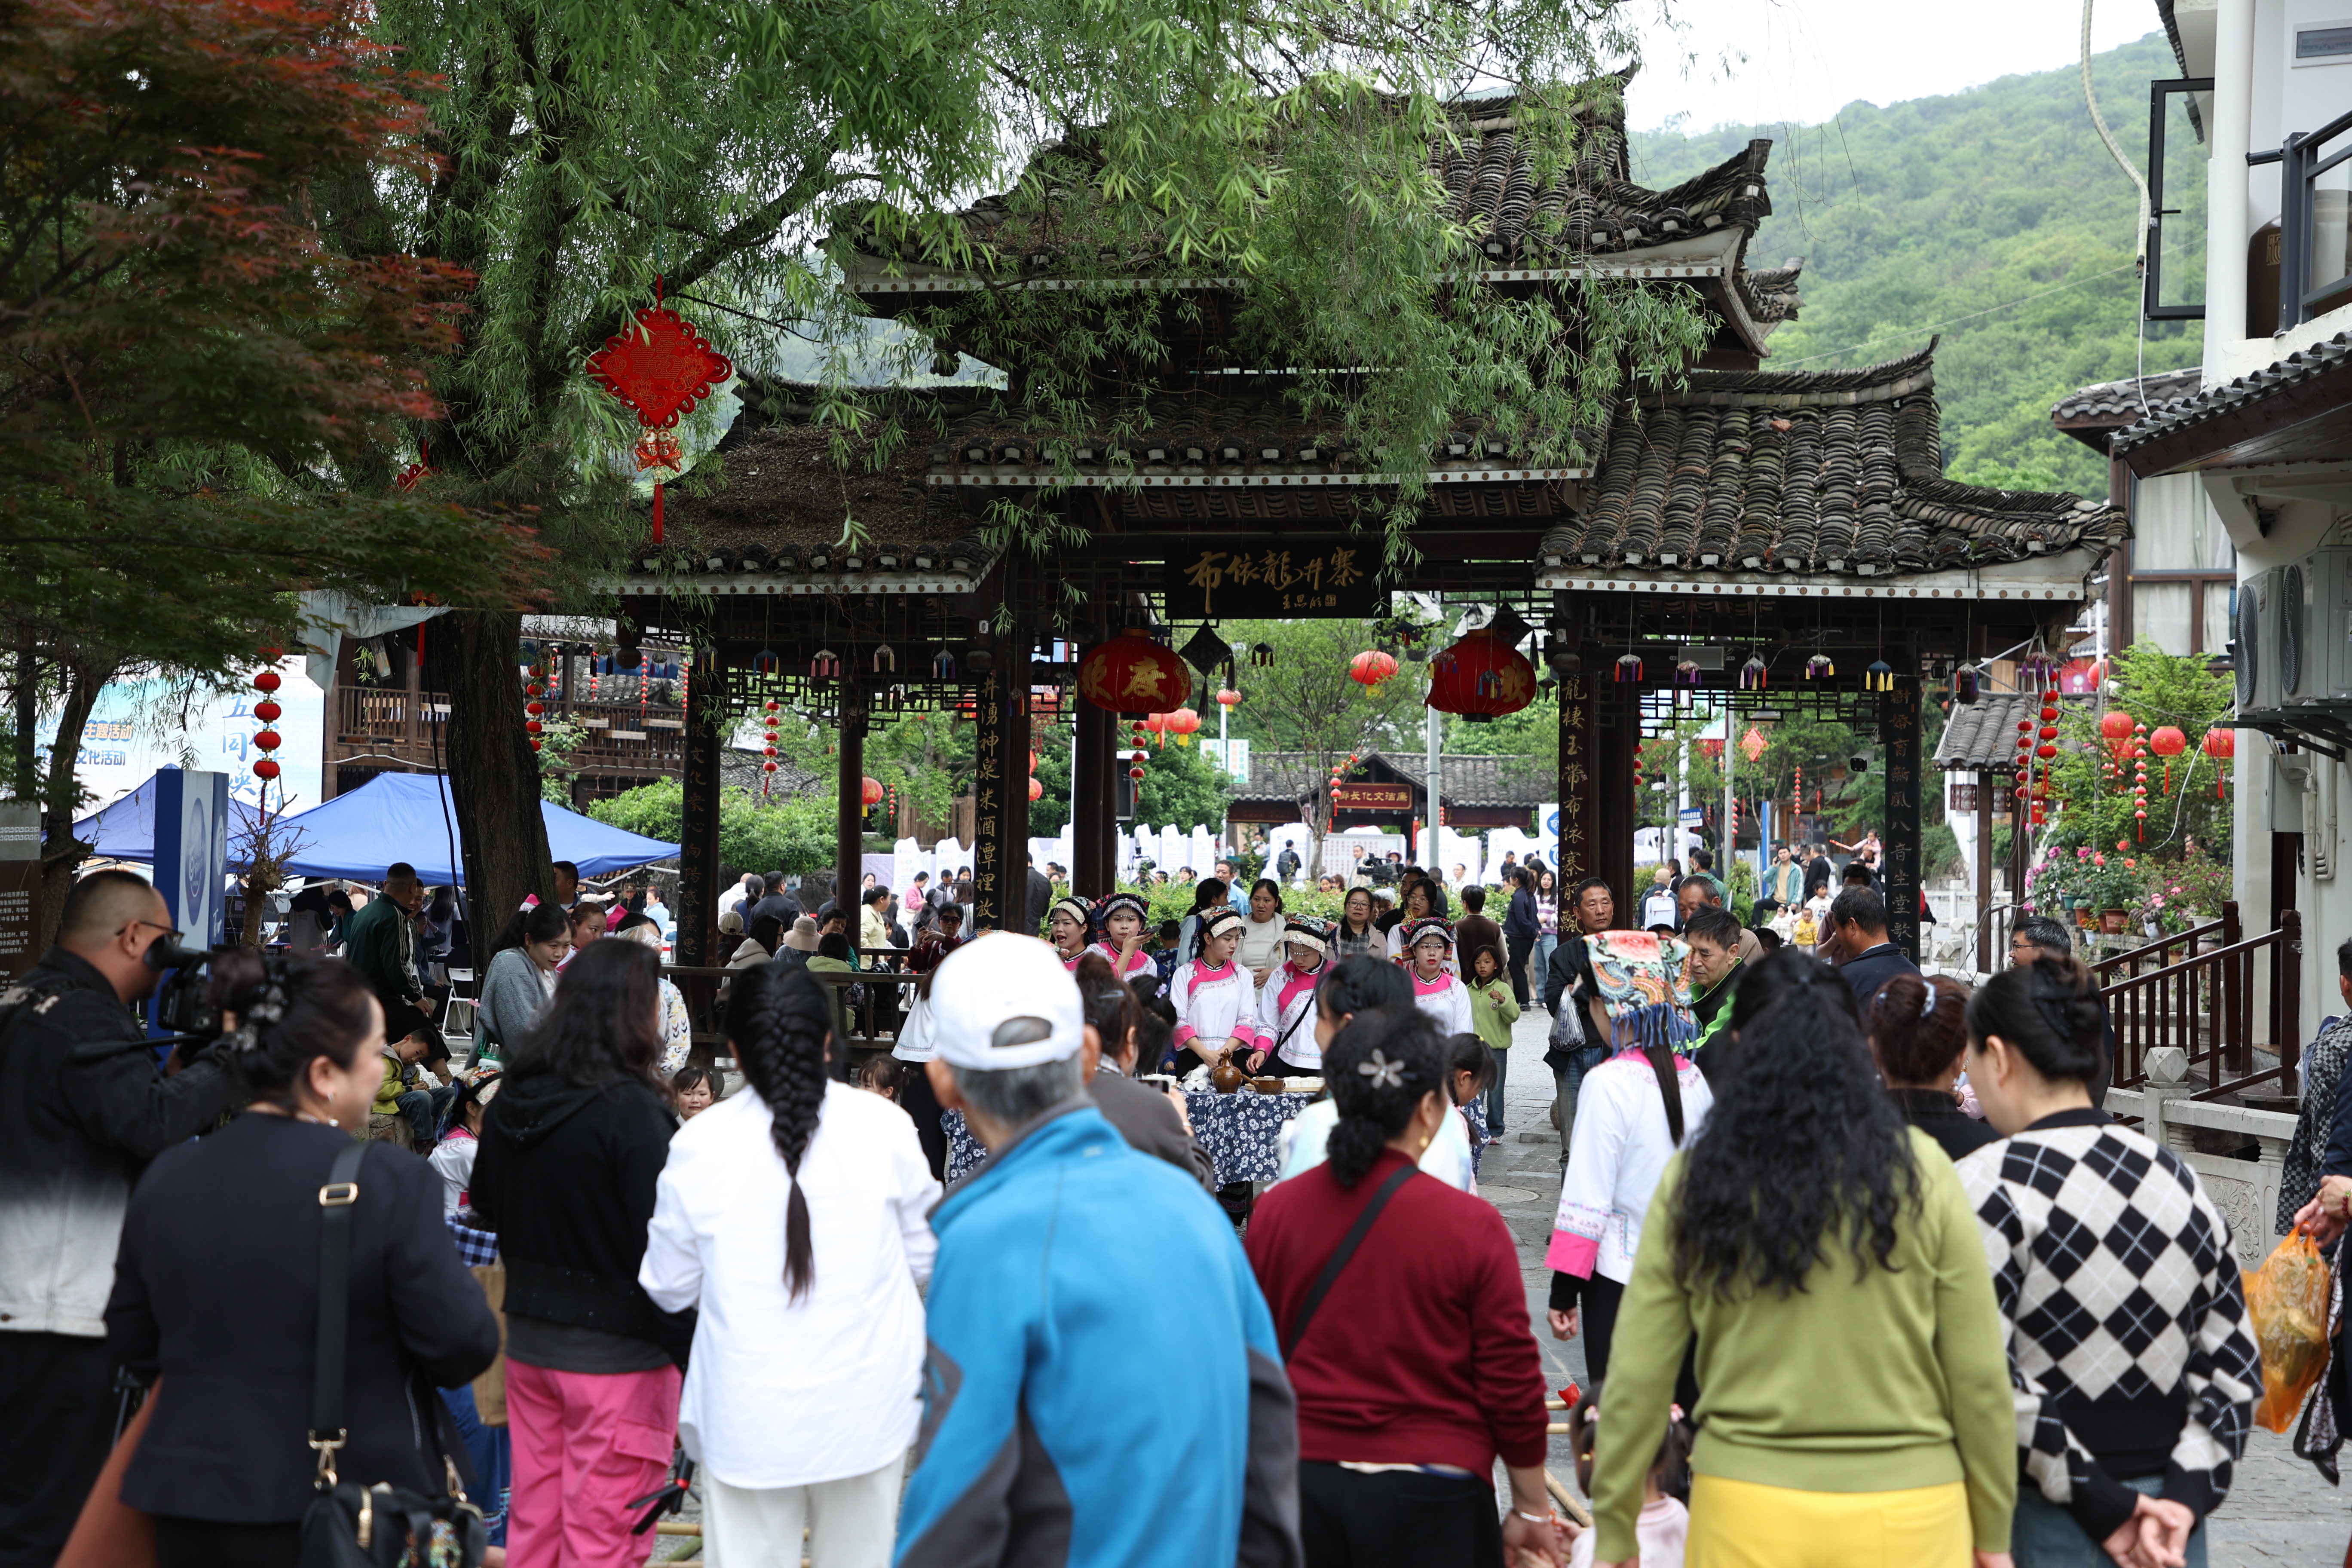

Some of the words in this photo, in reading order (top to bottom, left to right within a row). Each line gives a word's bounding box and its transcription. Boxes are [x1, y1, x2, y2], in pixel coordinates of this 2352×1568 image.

[630, 330, 683, 381] 福
[1183, 546, 1363, 614] 布依龍井寨
[84, 723, 133, 741] 主题活动
[975, 676, 1000, 929] 井湧神泉米酒潭裡放
